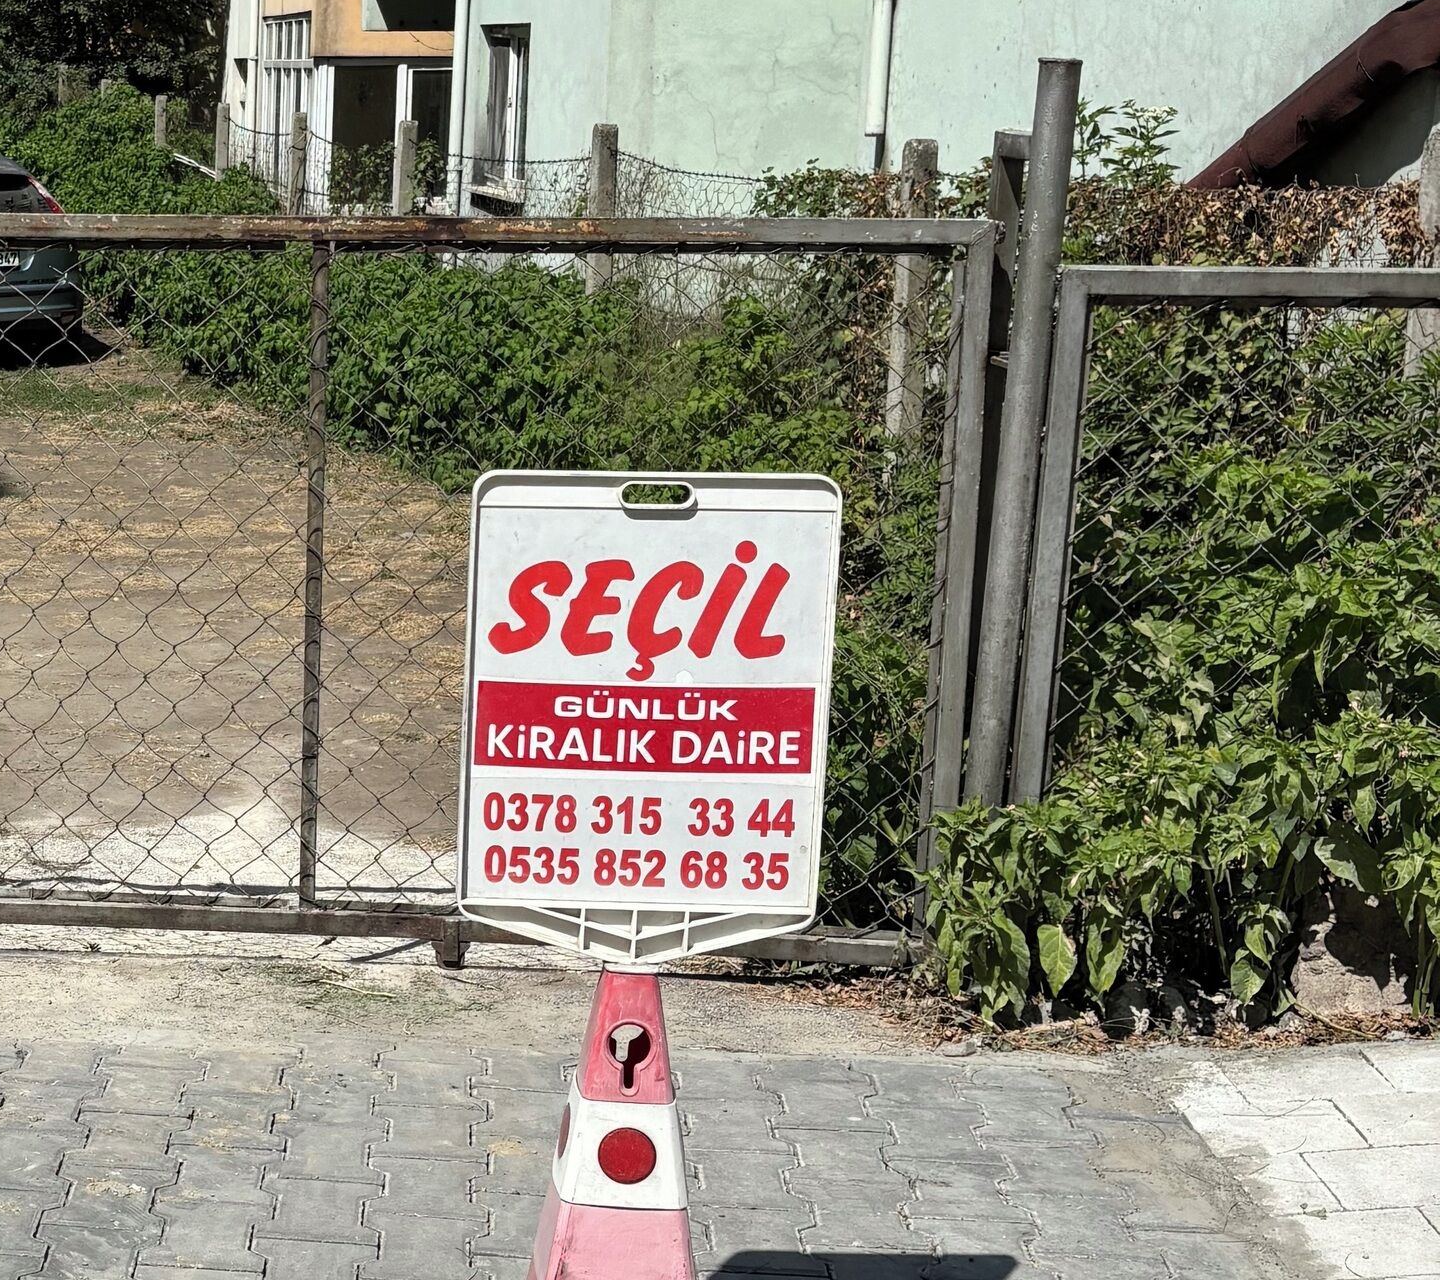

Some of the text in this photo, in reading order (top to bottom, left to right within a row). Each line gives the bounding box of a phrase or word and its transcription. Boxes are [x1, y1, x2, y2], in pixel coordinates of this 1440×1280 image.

[554, 690, 738, 721] GÜNLÜK
[483, 792, 795, 837] 0378 315 33 44
[484, 845, 789, 891] 0535 852 68 35
